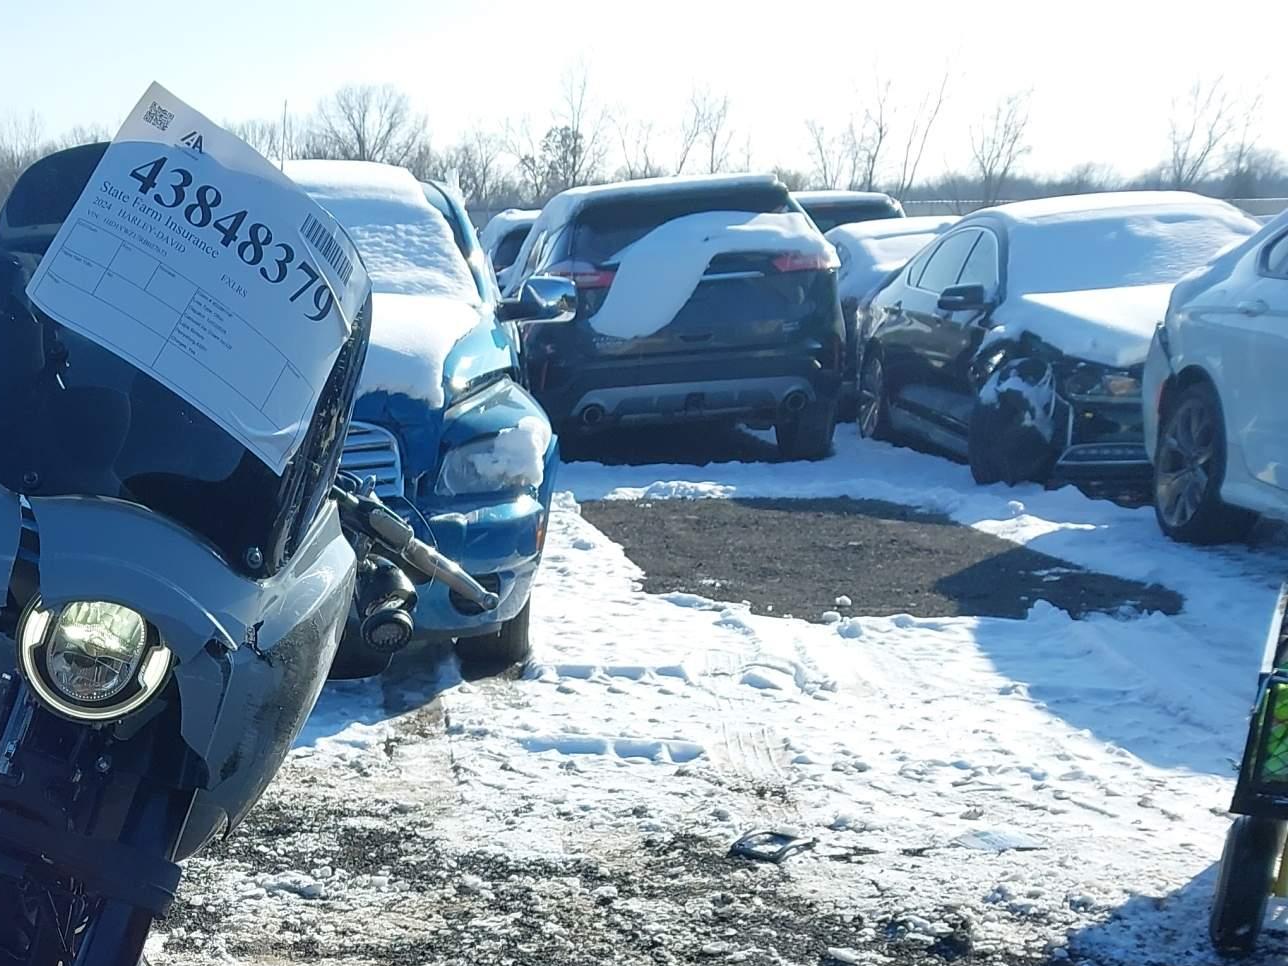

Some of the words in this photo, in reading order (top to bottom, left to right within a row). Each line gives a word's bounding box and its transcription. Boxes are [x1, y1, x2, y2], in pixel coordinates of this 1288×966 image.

[92, 196, 113, 211] 2024
[117, 208, 187, 254] HARLEY-DAVID
[220, 273, 249, 299] FXLRS
[99, 180, 131, 203] State
[131, 196, 163, 223] Farm
[164, 215, 220, 260] Insurance
[128, 156, 334, 323] 43848379
